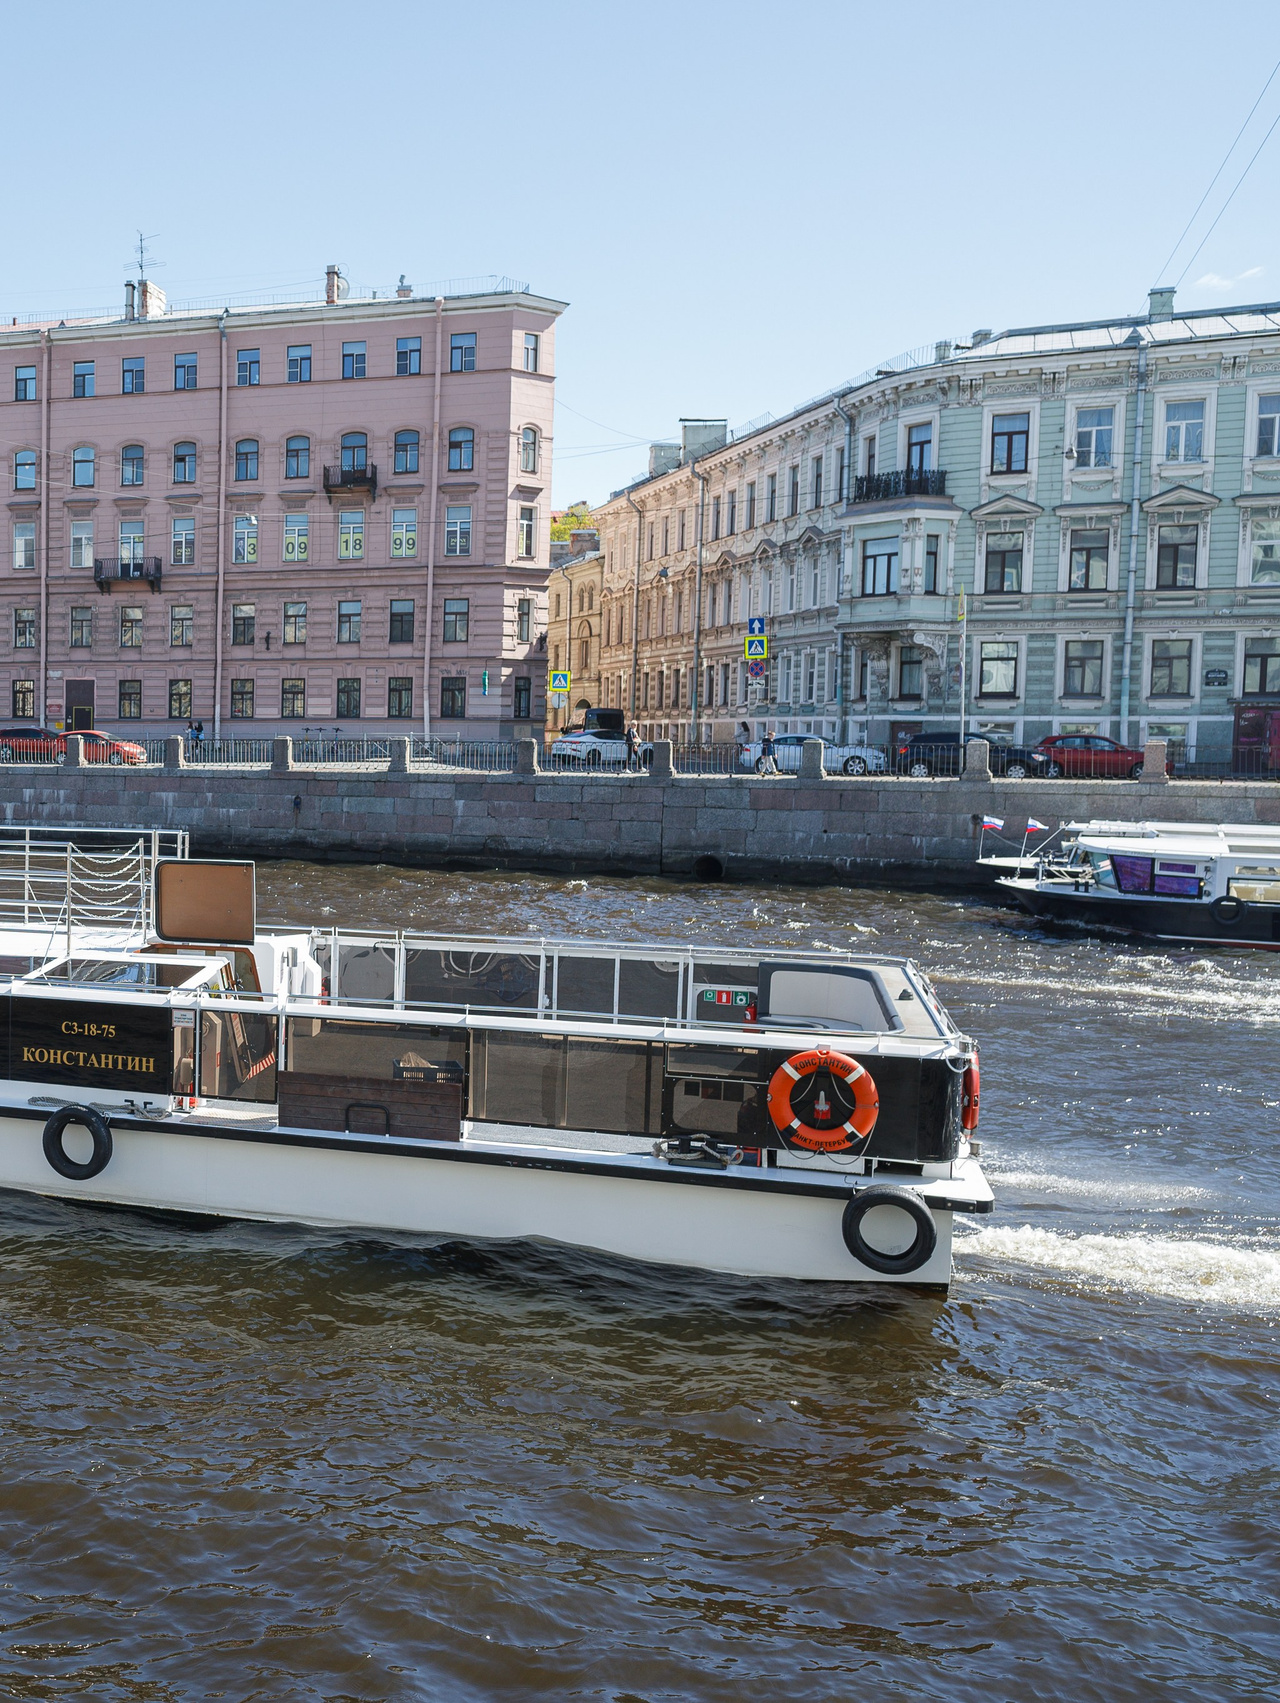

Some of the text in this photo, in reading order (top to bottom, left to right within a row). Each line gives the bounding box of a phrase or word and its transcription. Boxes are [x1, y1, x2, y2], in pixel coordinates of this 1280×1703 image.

[247, 537, 416, 556] 3 09 18 99
[22, 1046, 156, 1073] КОНСТАНТИН
[792, 1057, 854, 1075] КОНСТАНТИН
[793, 1132, 848, 1148] АНКТ-ПЕТЕРБУ
